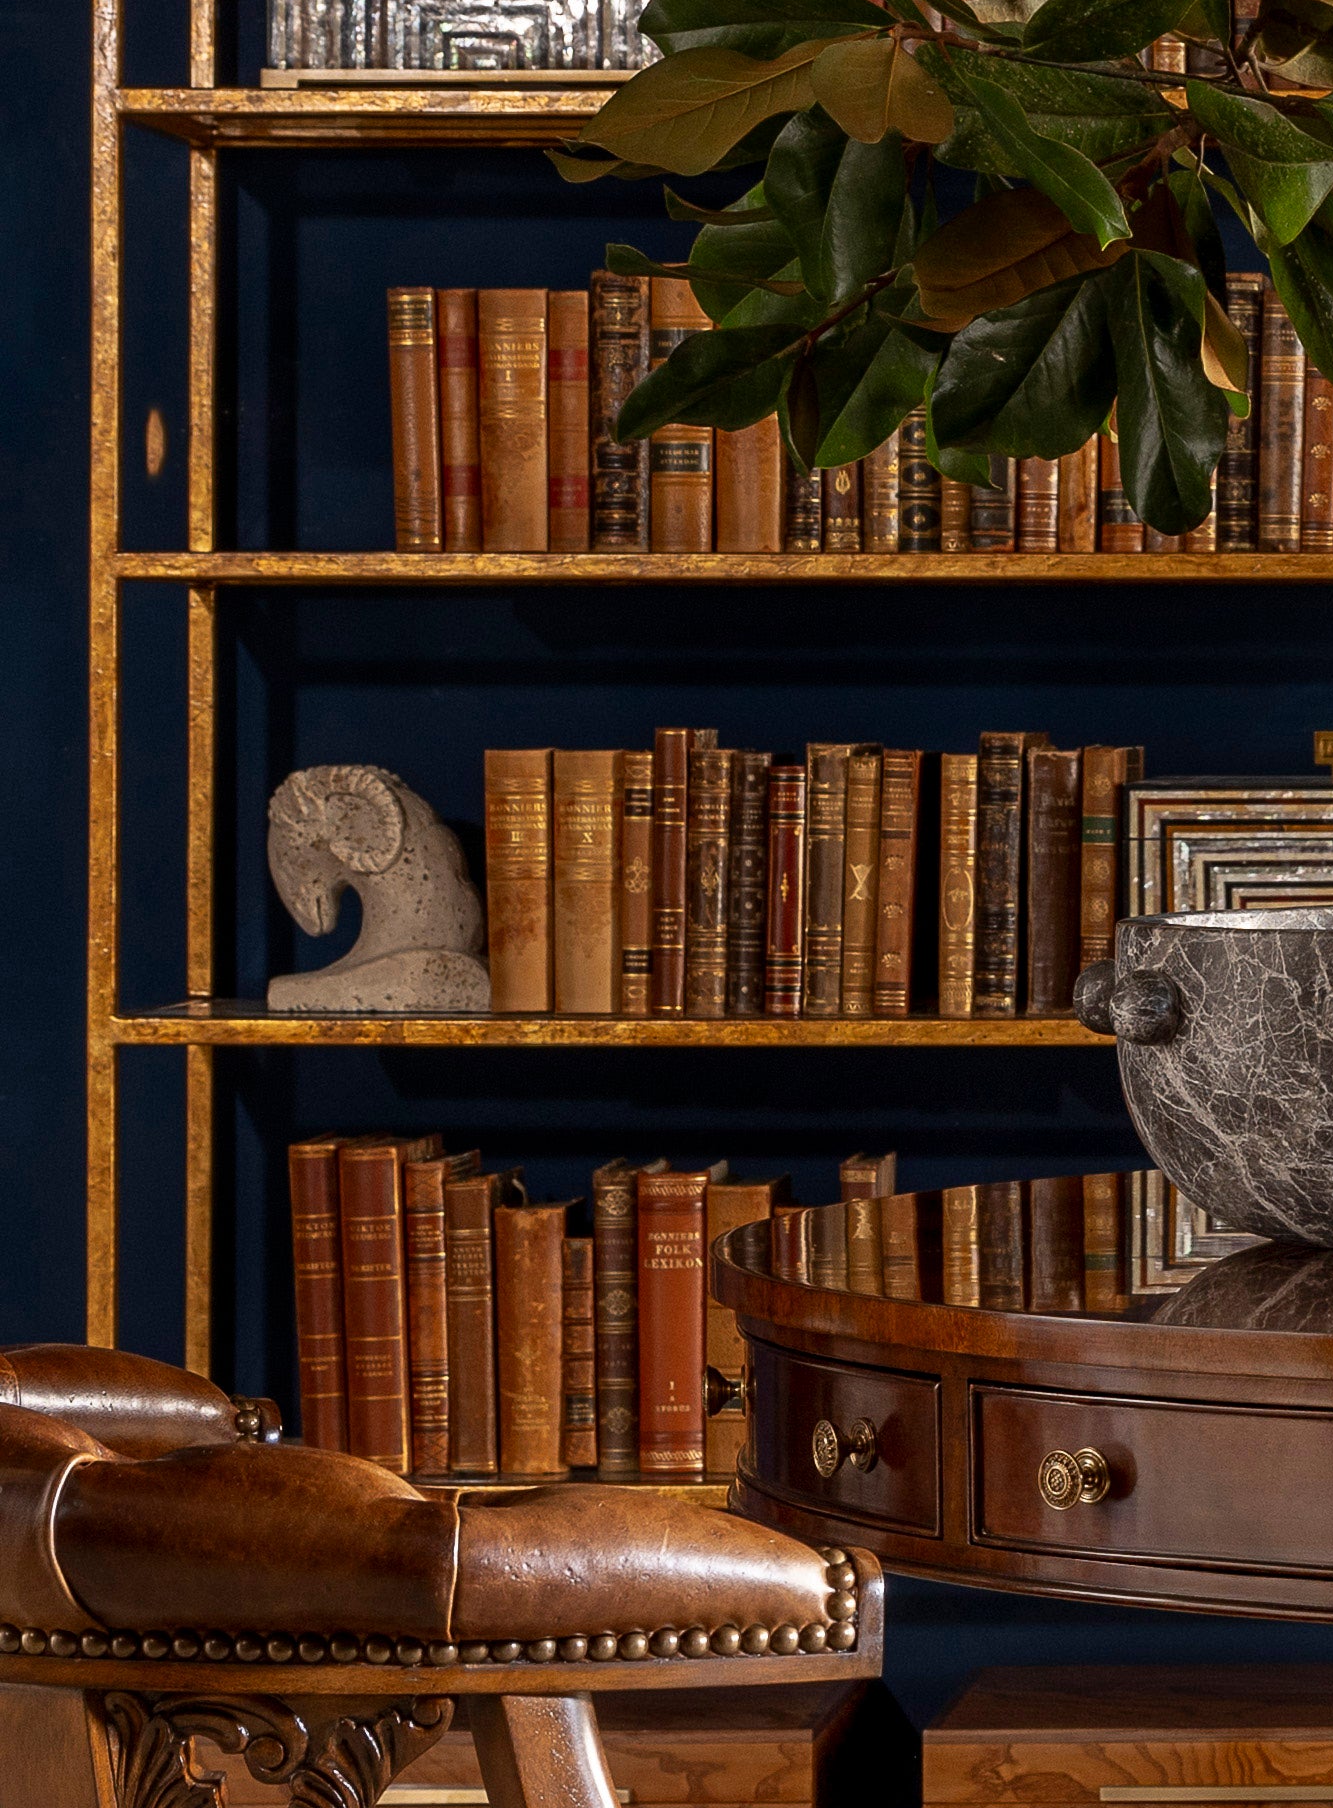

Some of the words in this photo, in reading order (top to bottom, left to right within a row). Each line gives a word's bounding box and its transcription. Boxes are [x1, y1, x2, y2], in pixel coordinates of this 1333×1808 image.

[560, 804, 612, 813] BONNIER
[648, 1231, 700, 1240] BONNIERS
[656, 1244, 692, 1255] FOLK
[644, 1257, 703, 1268] LEXIKON
